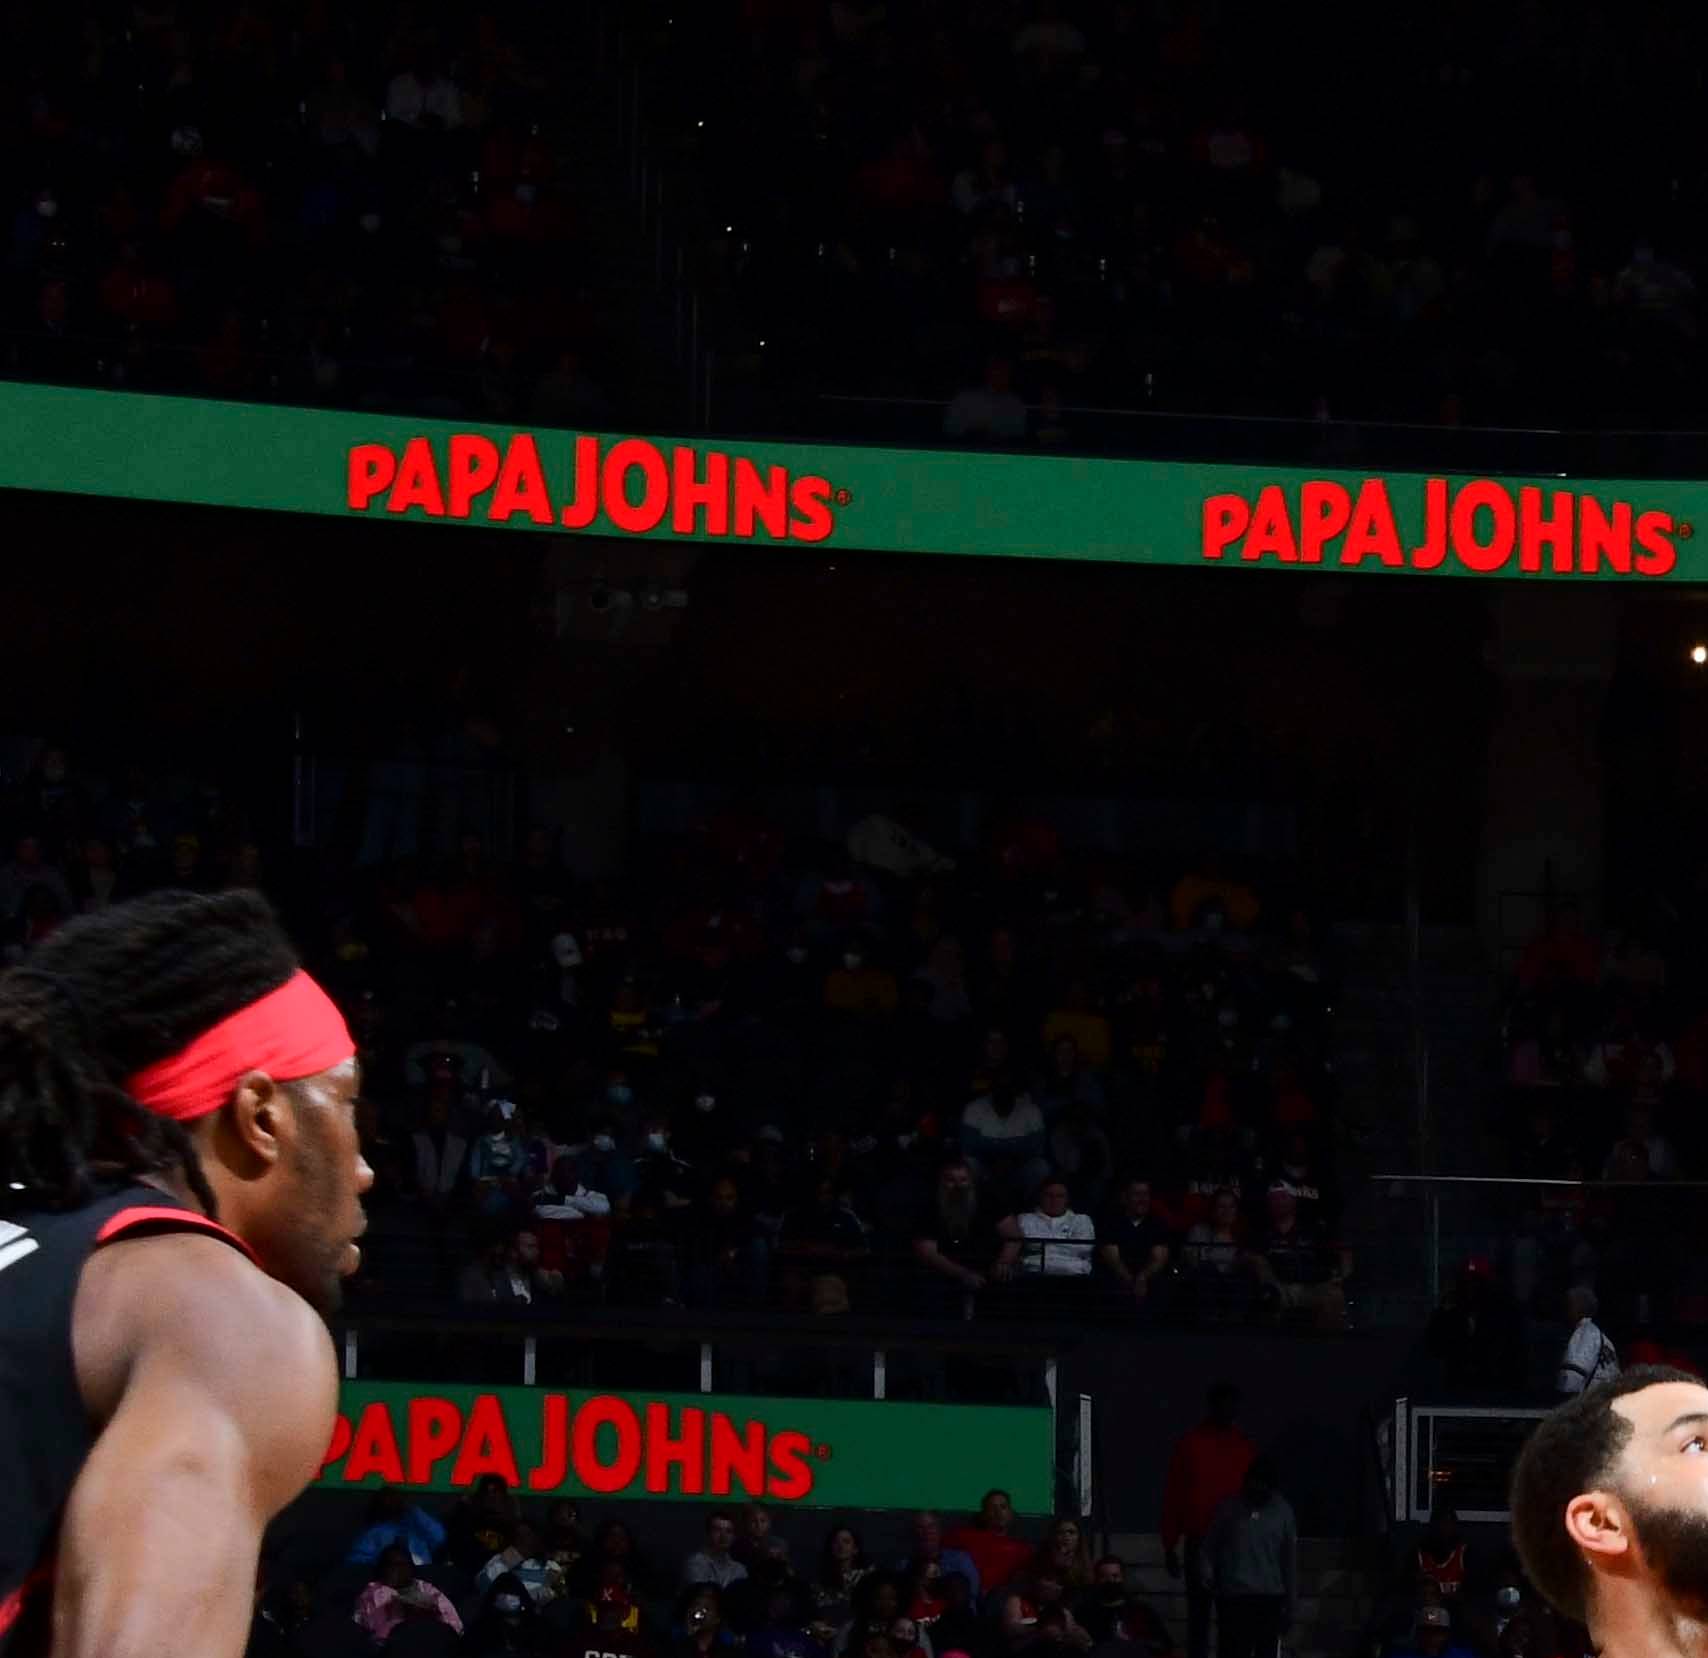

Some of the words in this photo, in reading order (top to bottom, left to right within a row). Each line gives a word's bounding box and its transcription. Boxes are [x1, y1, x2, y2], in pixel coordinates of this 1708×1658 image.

[347, 433, 555, 525] PAPA
[561, 435, 834, 542] JOHNS
[1202, 477, 1405, 567] PAPA
[1411, 478, 1677, 576] JOHNS
[528, 1394, 813, 1499] JOHNS
